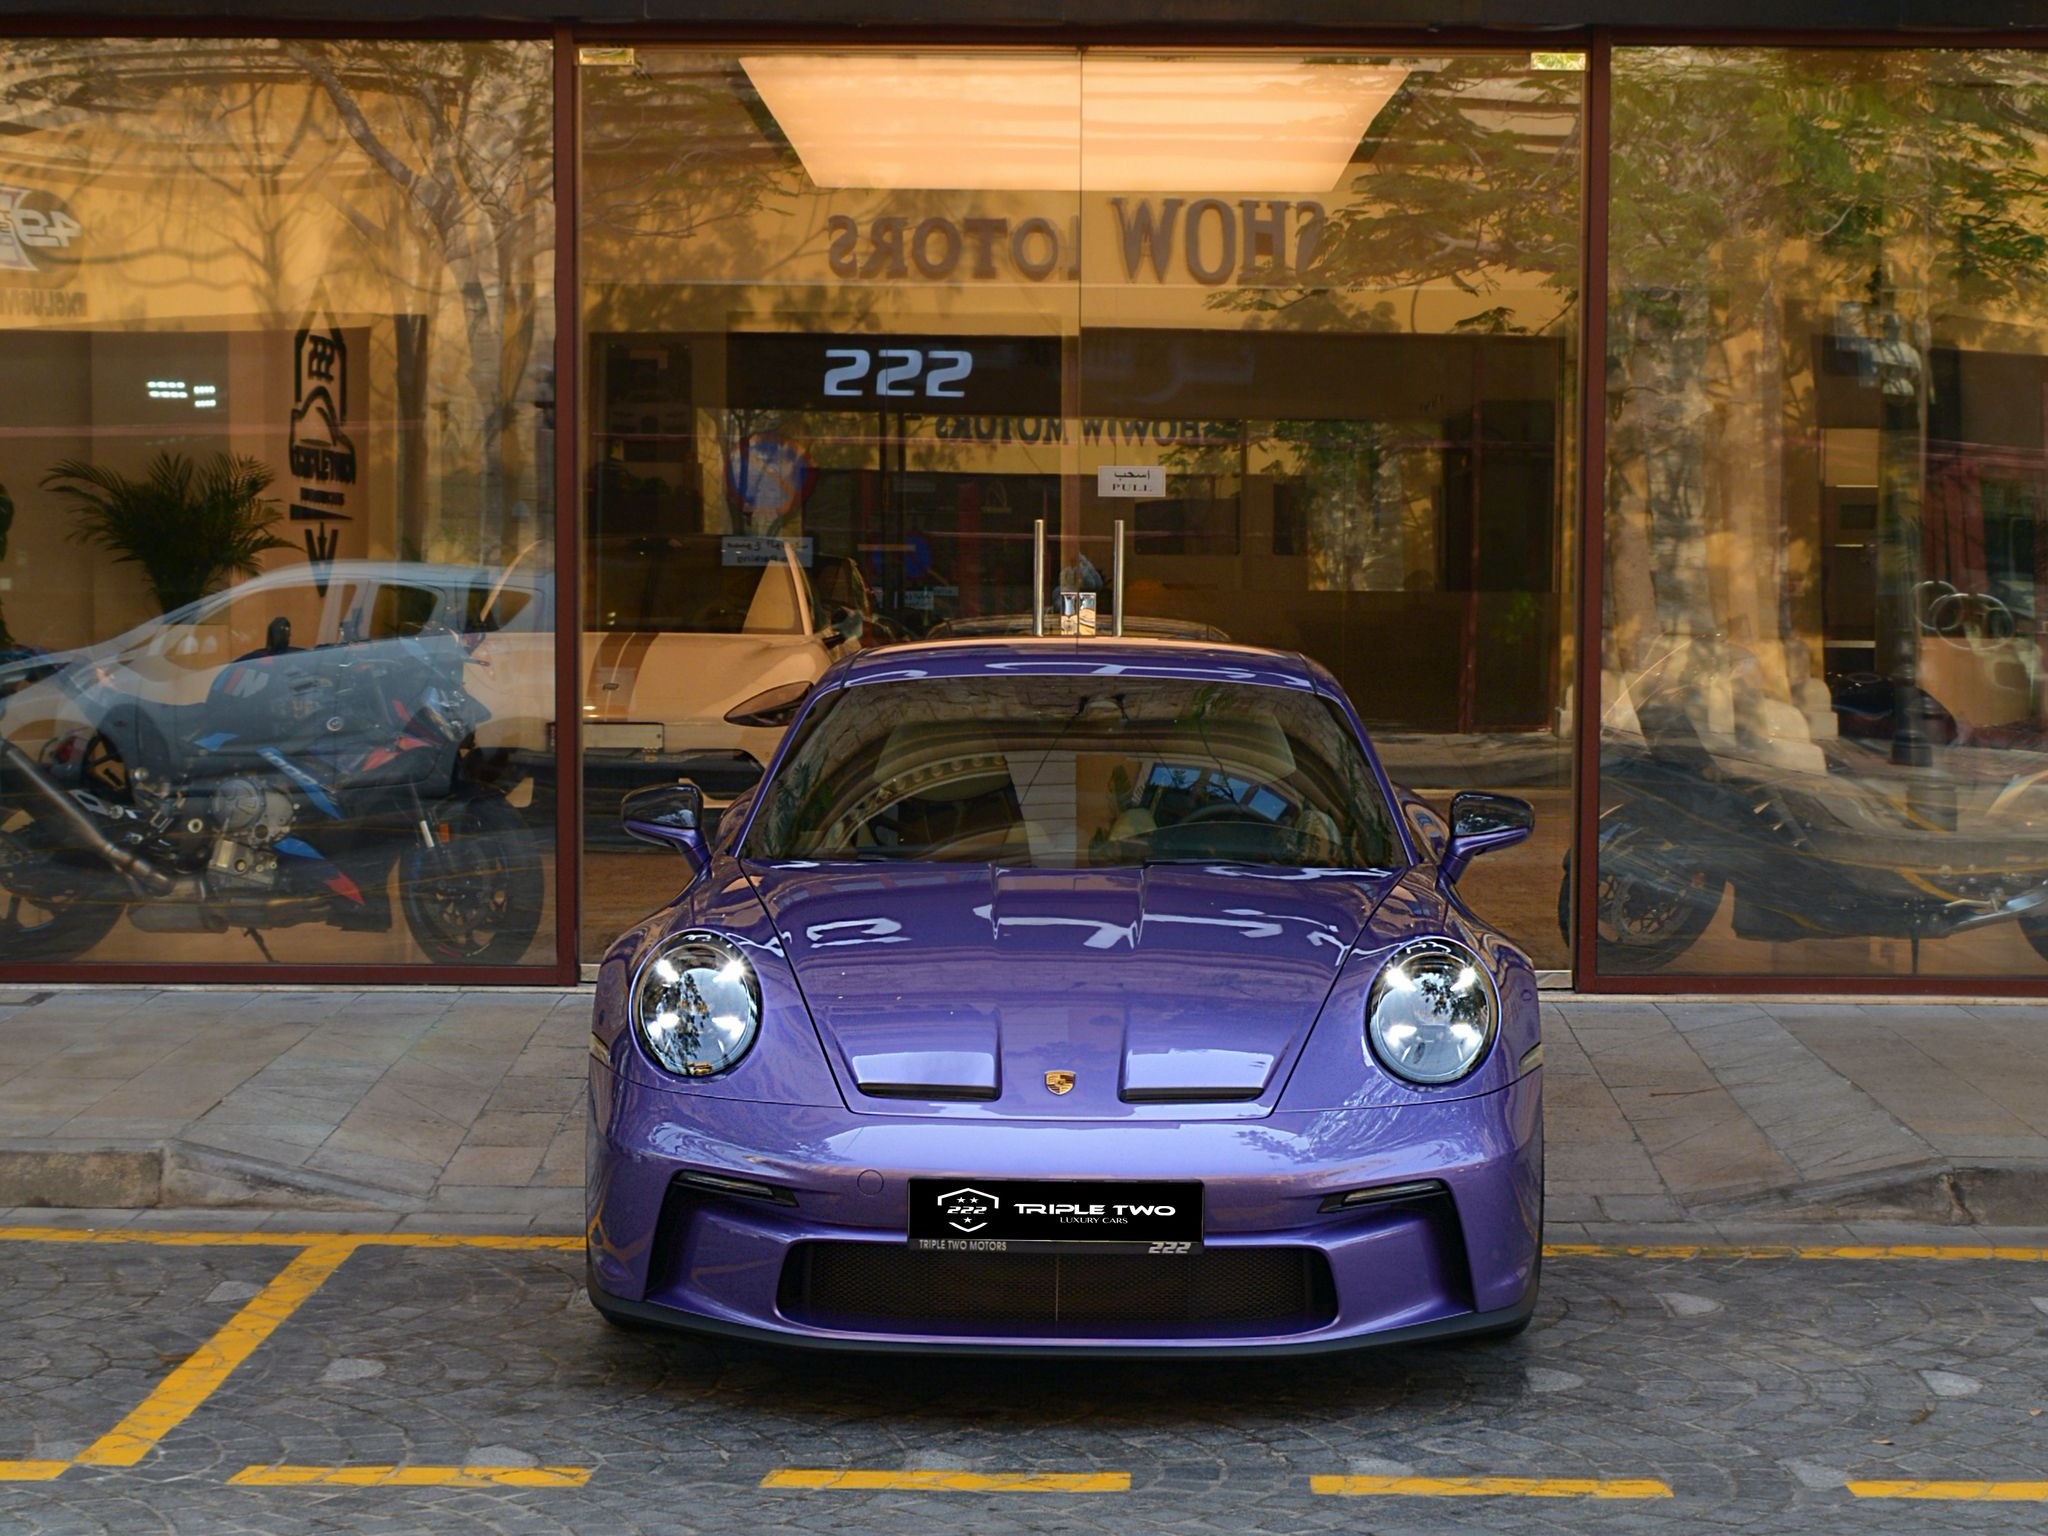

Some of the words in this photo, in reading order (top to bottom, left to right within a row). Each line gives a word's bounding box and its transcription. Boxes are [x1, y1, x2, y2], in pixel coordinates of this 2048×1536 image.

[823, 349, 973, 396] 222
[1112, 483, 1152, 492] PULL
[947, 1205, 987, 1214] 222
[1014, 1203, 1106, 1215] TRIPLE
[1112, 1204, 1176, 1216] TWO
[1060, 1216, 1100, 1224] LUXURY
[919, 1239, 945, 1250] TRIPLE
[947, 1240, 967, 1251] TWO
[969, 1241, 1007, 1252] MOTORS
[1148, 1241, 1192, 1254] 222
